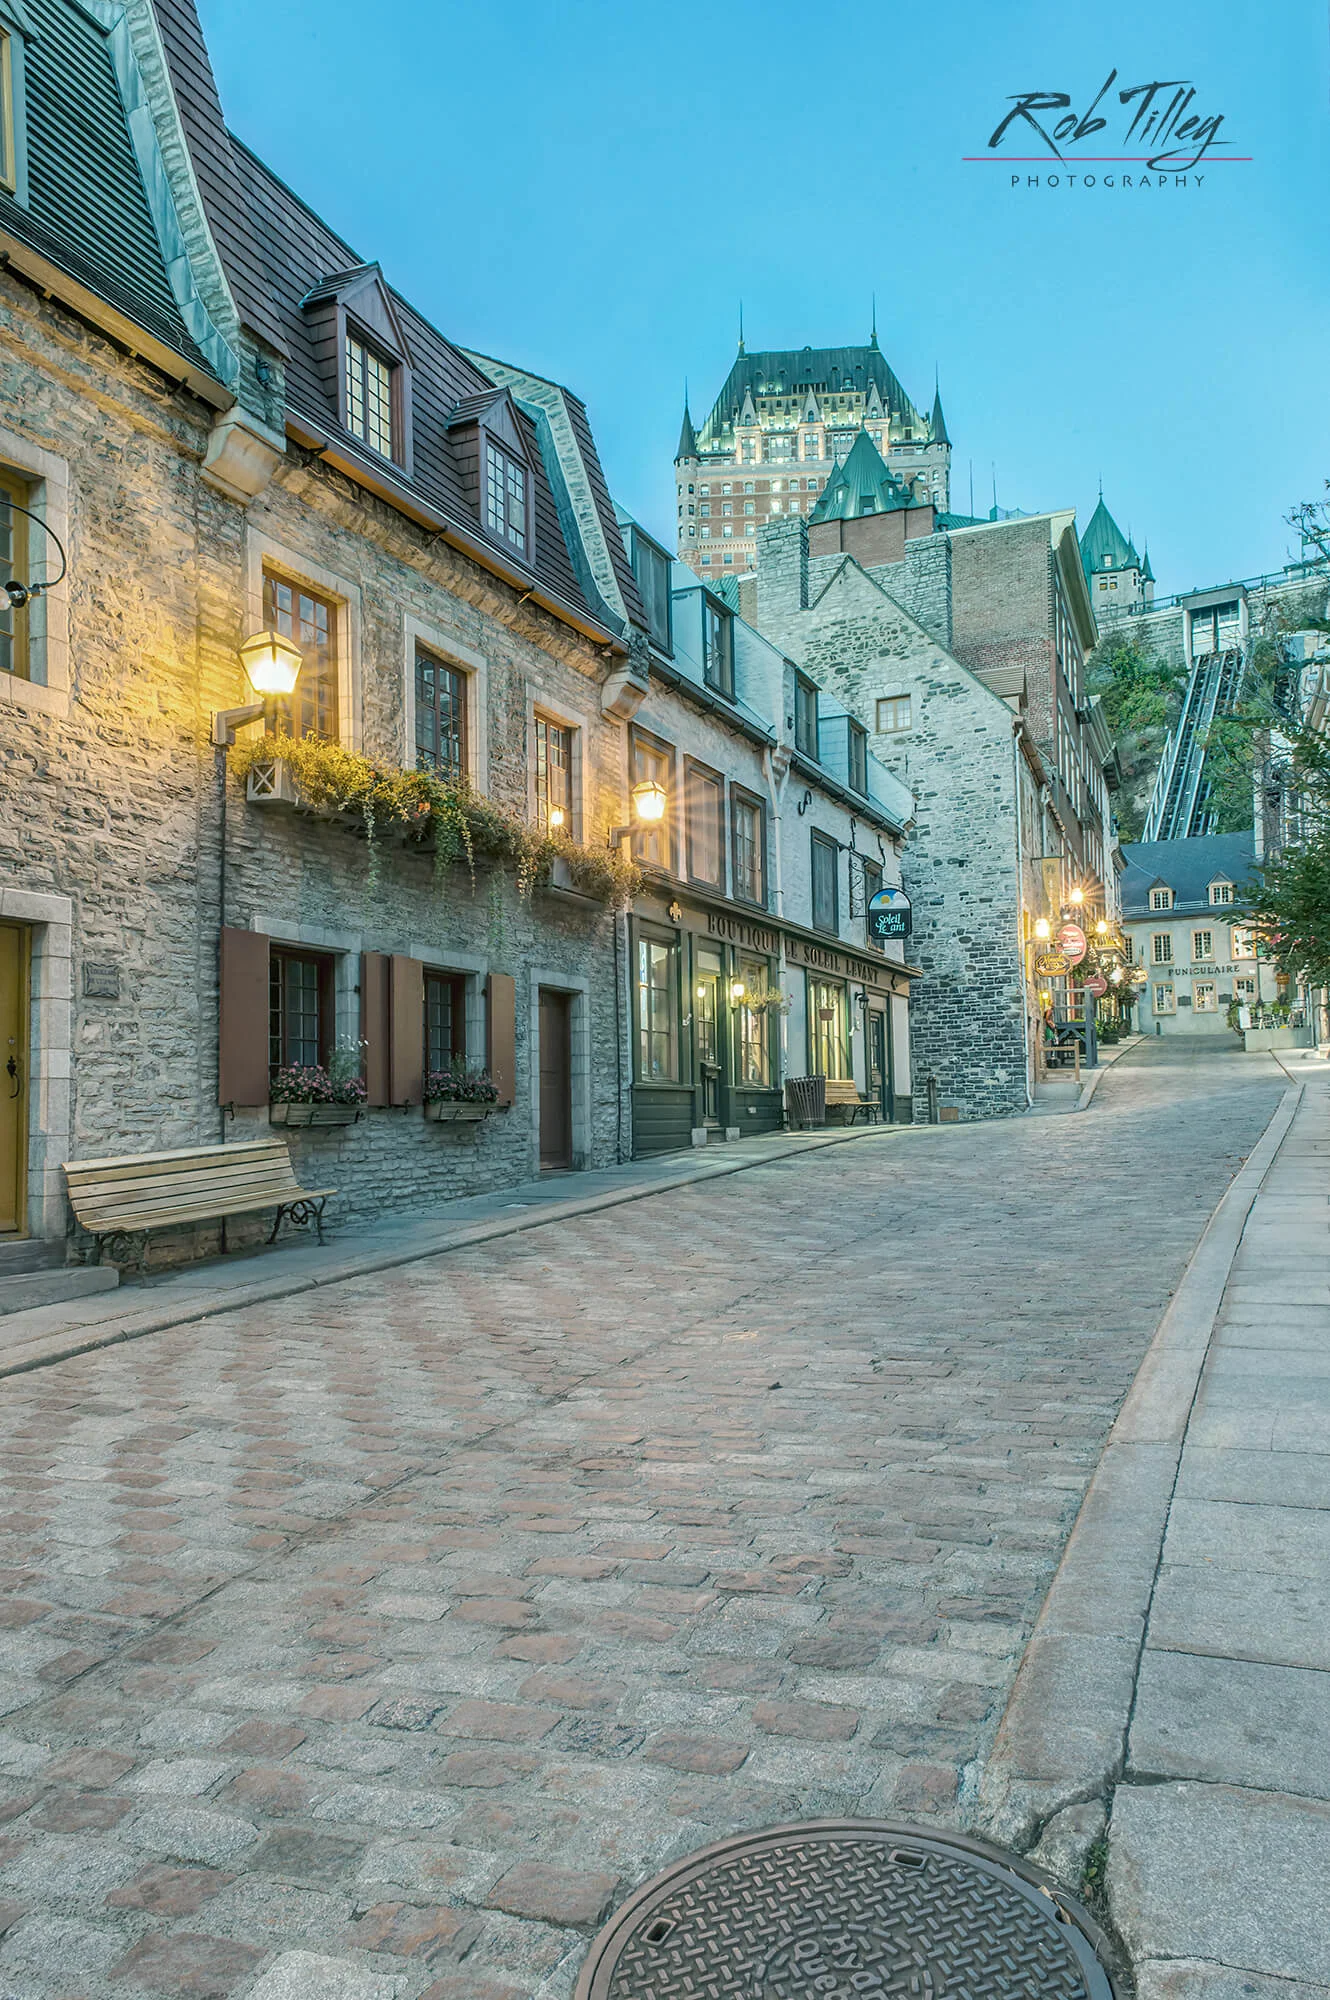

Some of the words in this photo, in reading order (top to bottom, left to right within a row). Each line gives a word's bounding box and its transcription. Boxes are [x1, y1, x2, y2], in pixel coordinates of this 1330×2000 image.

[878, 913, 901, 925] Soleil
[707, 913, 780, 953] BOUTIQUE
[784, 938, 798, 960] LE
[803, 943, 840, 972] SOLEIL
[846, 959, 878, 985] LEVANT
[1168, 964, 1240, 977] FUNICULAIRE
